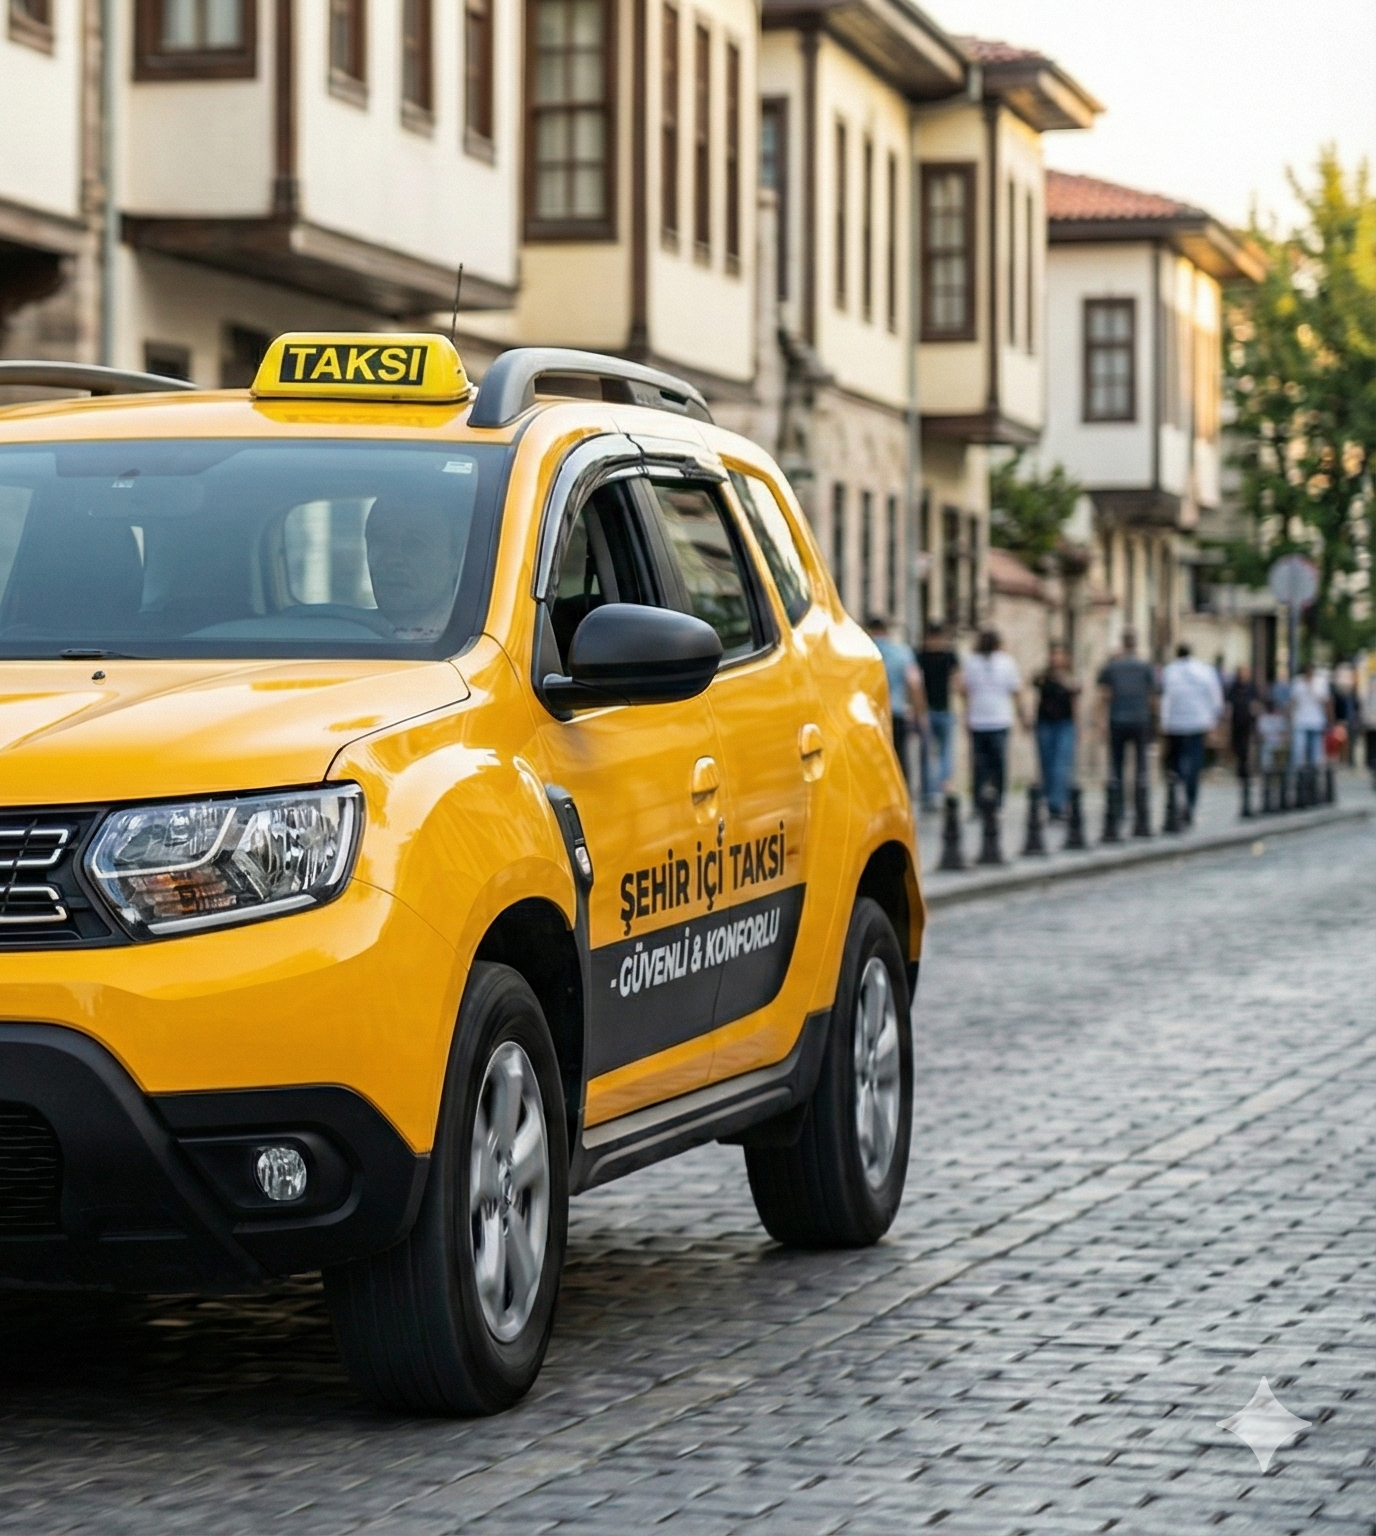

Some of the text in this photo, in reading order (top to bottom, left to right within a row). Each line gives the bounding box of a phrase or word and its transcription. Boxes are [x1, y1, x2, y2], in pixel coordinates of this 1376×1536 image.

[288, 347, 422, 381] TAKSI
[620, 820, 785, 936] ŞEHİR İÇİ TAKSİ
[619, 927, 691, 998] GÜVENLİ
[690, 934, 703, 974] &
[704, 907, 781, 969] KONFORLU
